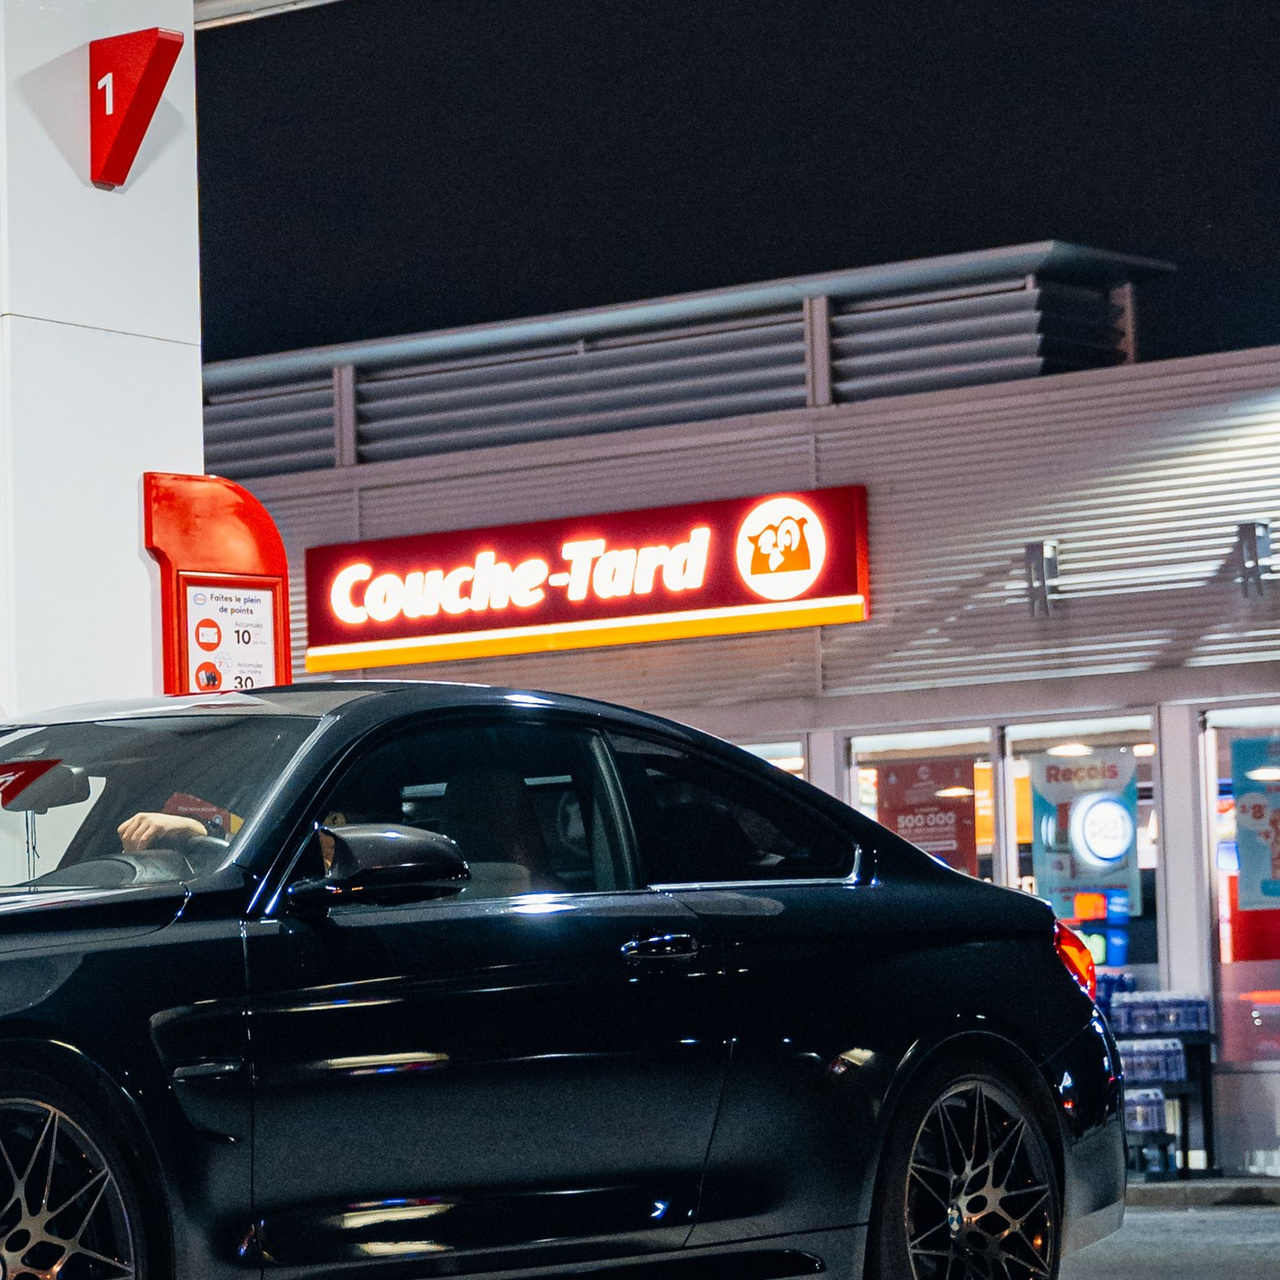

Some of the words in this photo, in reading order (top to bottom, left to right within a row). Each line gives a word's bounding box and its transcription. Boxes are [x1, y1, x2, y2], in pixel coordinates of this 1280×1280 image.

[97, 72, 113, 115] 1
[329, 526, 711, 624] Couche-Tard
[210, 593, 232, 602] Faites
[234, 595, 241, 603] le
[243, 596, 262, 605] plein
[219, 605, 228, 613] de
[230, 607, 254, 616] points
[234, 629, 252, 645] 10
[234, 676, 254, 689] 30
